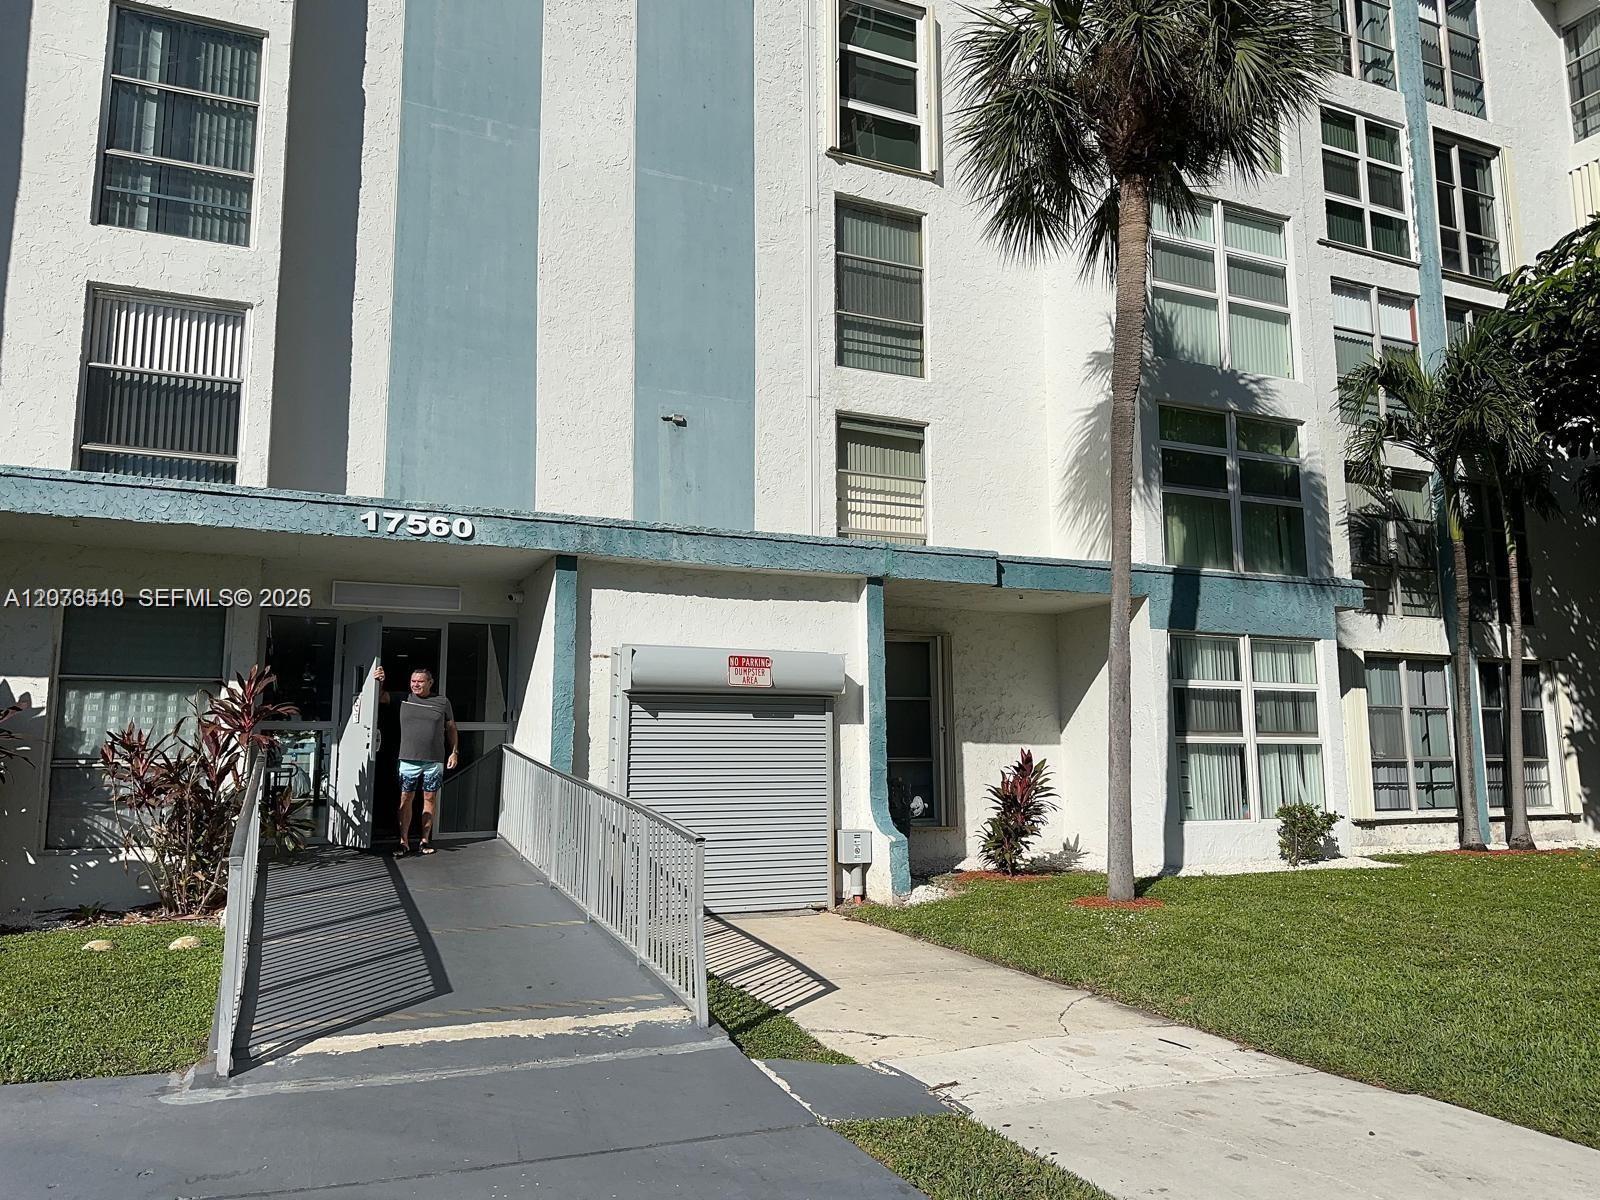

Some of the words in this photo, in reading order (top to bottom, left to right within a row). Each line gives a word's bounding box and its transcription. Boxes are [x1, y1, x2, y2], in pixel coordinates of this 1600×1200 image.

[360, 511, 474, 538] 17560
[730, 657, 739, 667] NO
[741, 657, 771, 667] PARKING
[735, 668, 765, 677] DUMPSTER
[743, 677, 758, 685] AREA
